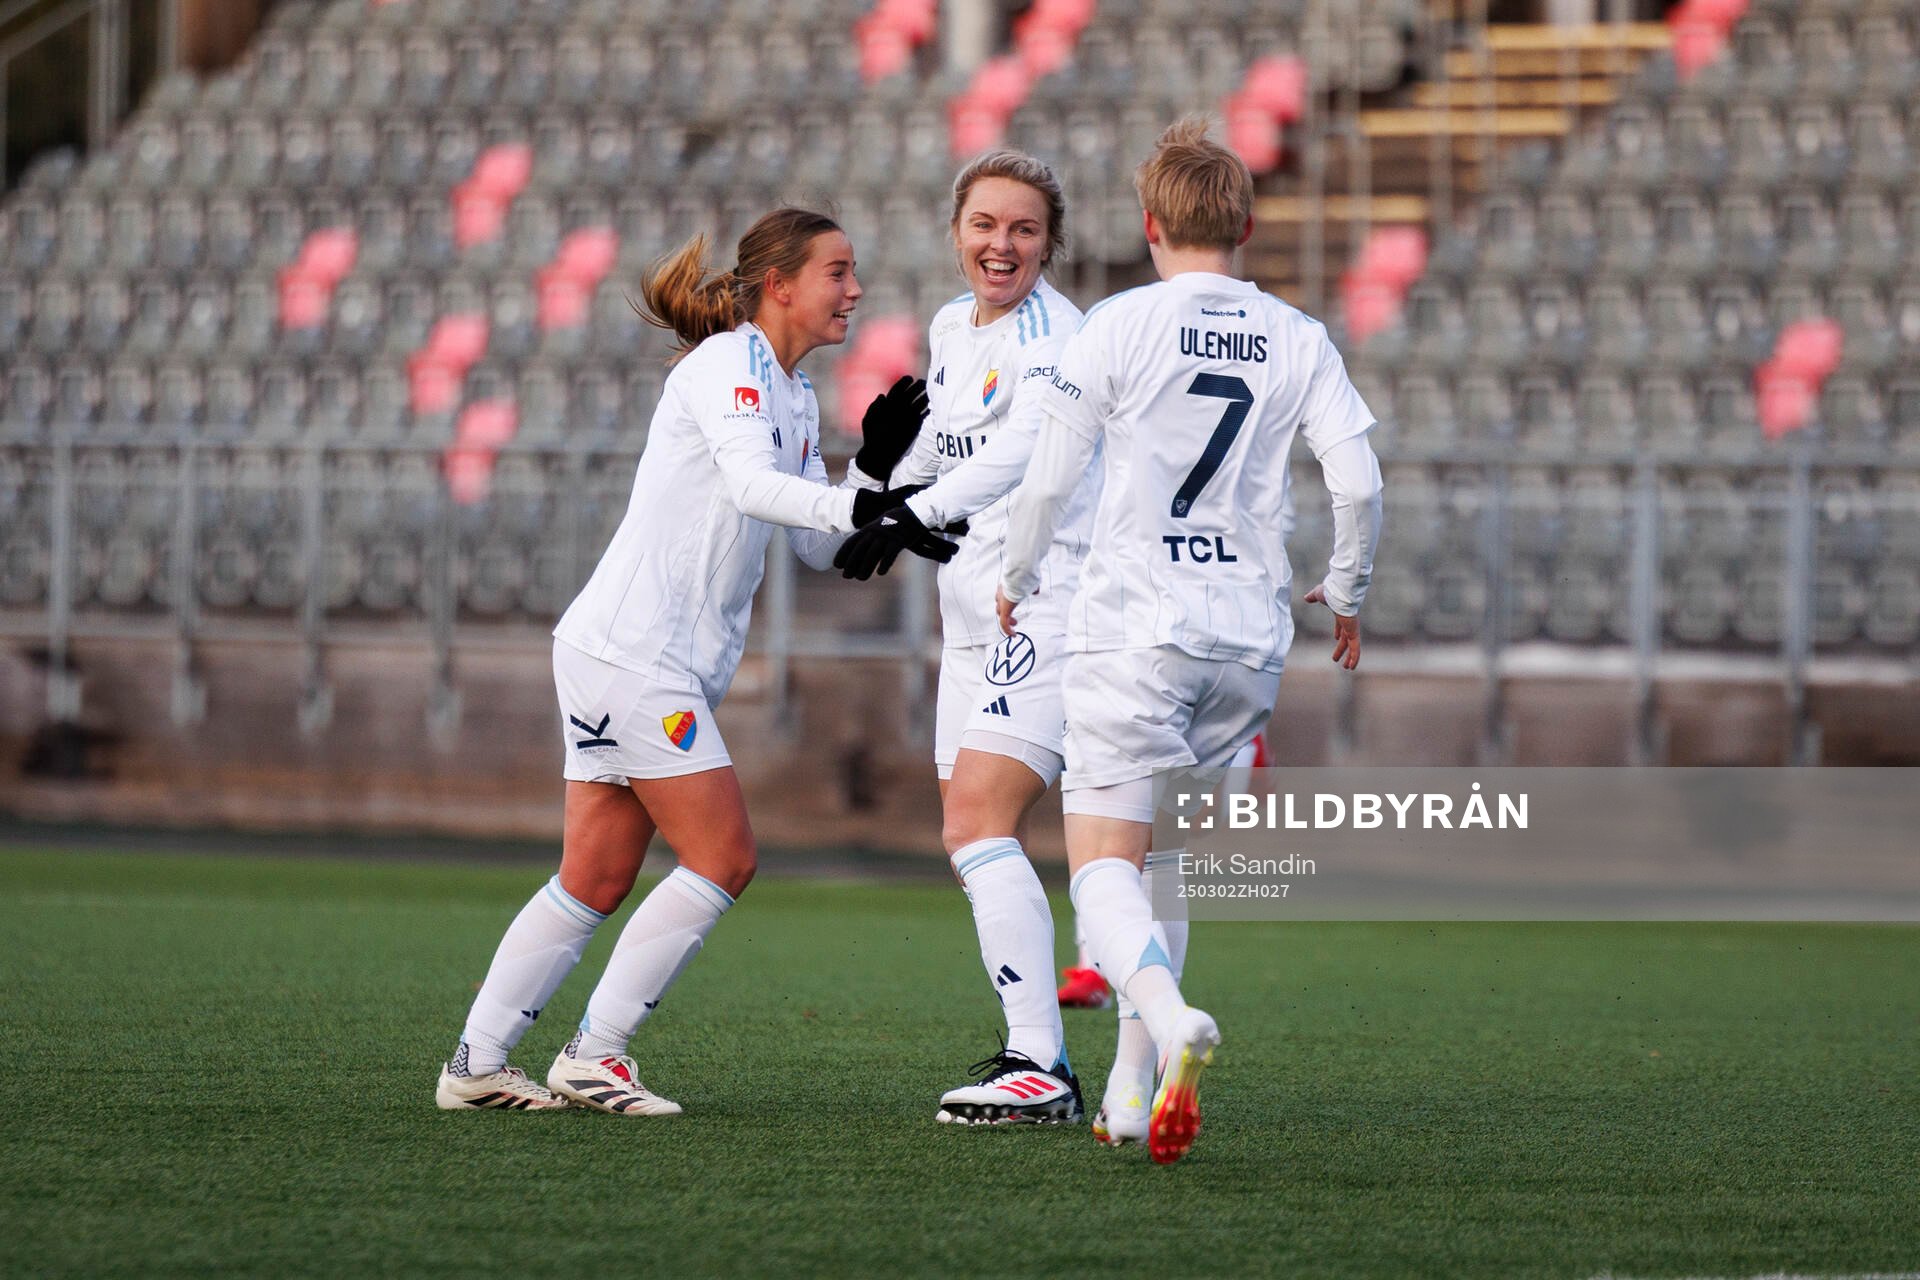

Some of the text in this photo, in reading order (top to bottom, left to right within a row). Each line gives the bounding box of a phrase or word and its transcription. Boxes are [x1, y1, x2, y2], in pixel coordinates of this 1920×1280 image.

[1201, 308, 1237, 317] Sundström
[1180, 326, 1268, 363] ULENIUS
[1171, 372, 1255, 519] 7
[1162, 535, 1238, 564] TCL
